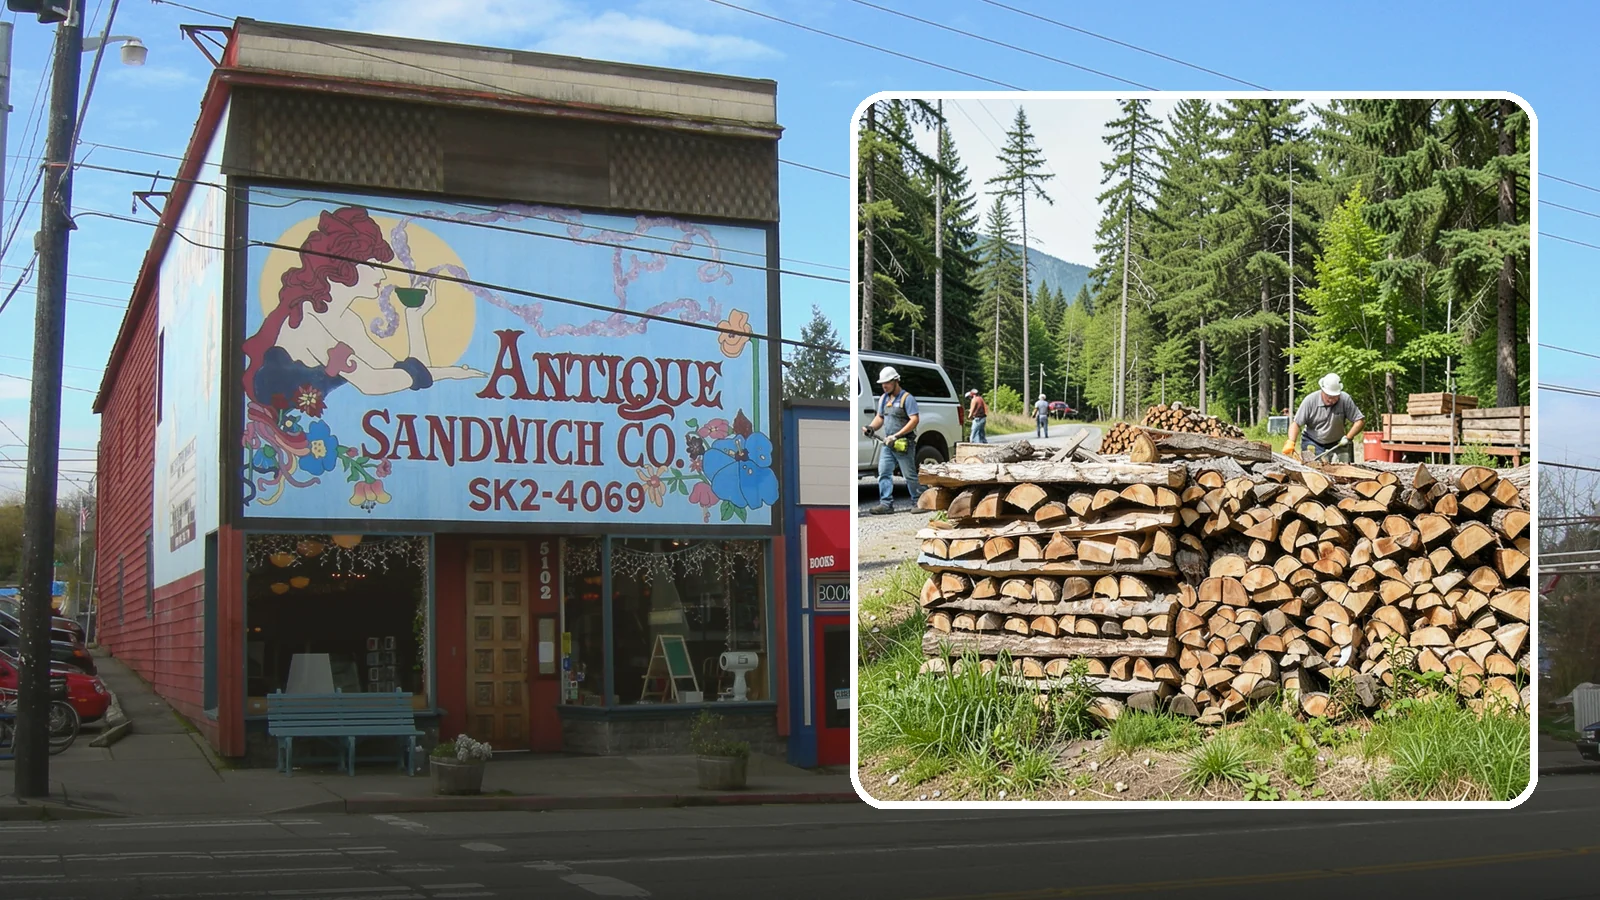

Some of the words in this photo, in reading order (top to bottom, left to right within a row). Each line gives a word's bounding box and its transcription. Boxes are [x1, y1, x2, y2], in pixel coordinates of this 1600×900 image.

[475, 328, 724, 421] ANTIQUE
[361, 408, 605, 467] SANDWICH
[616, 421, 685, 469] CO.
[468, 477, 646, 513] SK2-4069
[540, 541, 551, 600] 5102
[809, 555, 835, 569] BOOKS
